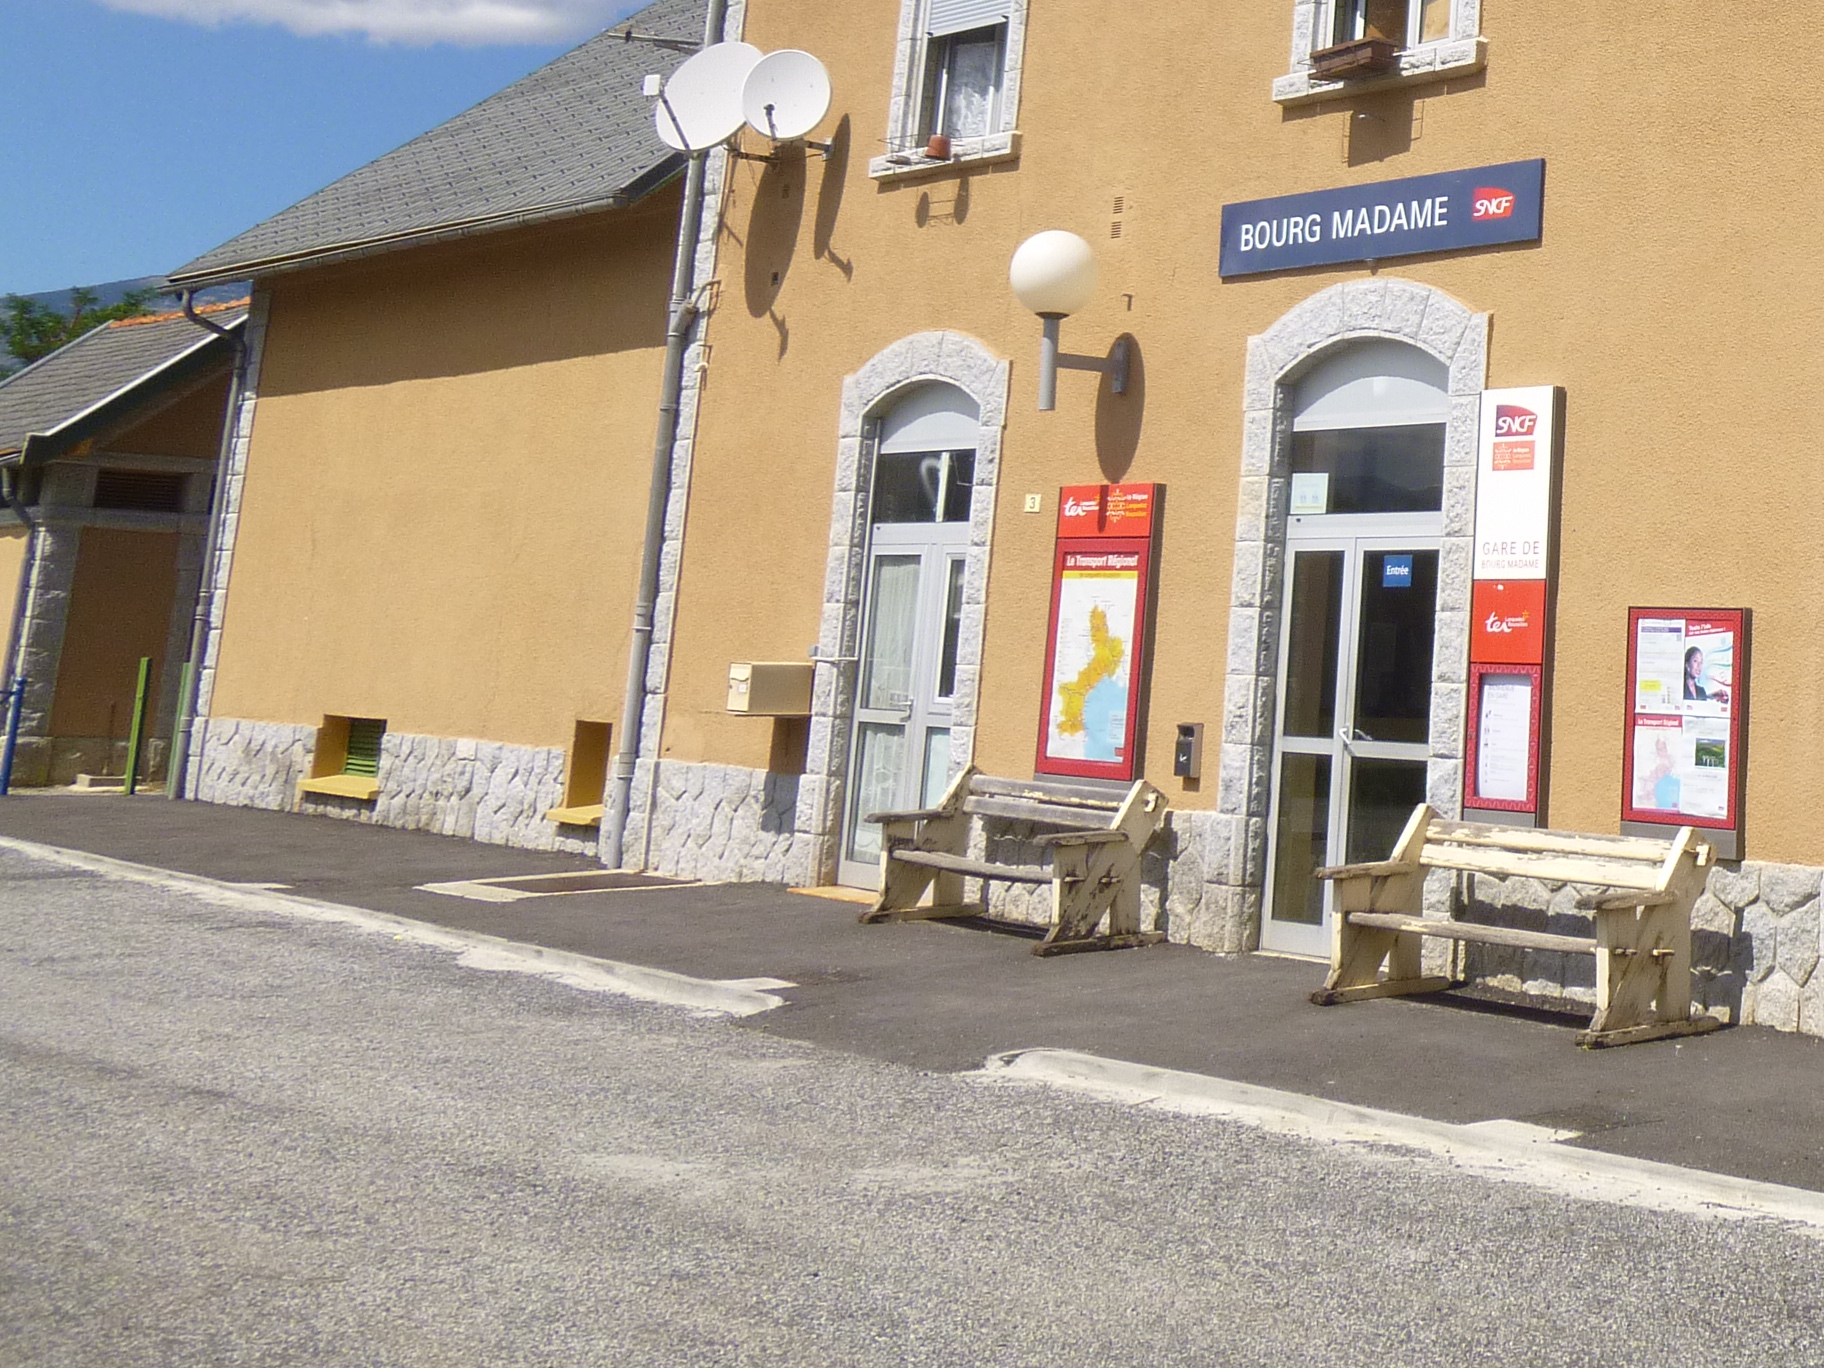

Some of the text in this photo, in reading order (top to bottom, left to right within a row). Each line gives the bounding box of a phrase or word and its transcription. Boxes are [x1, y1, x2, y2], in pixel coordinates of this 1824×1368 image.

[1473, 196, 1513, 217] SNCF
[1240, 196, 1449, 252] BOURG MADAME
[1497, 415, 1537, 434] SNCF
[1029, 496, 1036, 510] 3
[1482, 541, 1540, 556] GARE DE
[1066, 554, 1139, 569] Le Transport Régional
[1481, 559, 1539, 569] BOURG MADAME
[1386, 564, 1409, 576] Entrée
